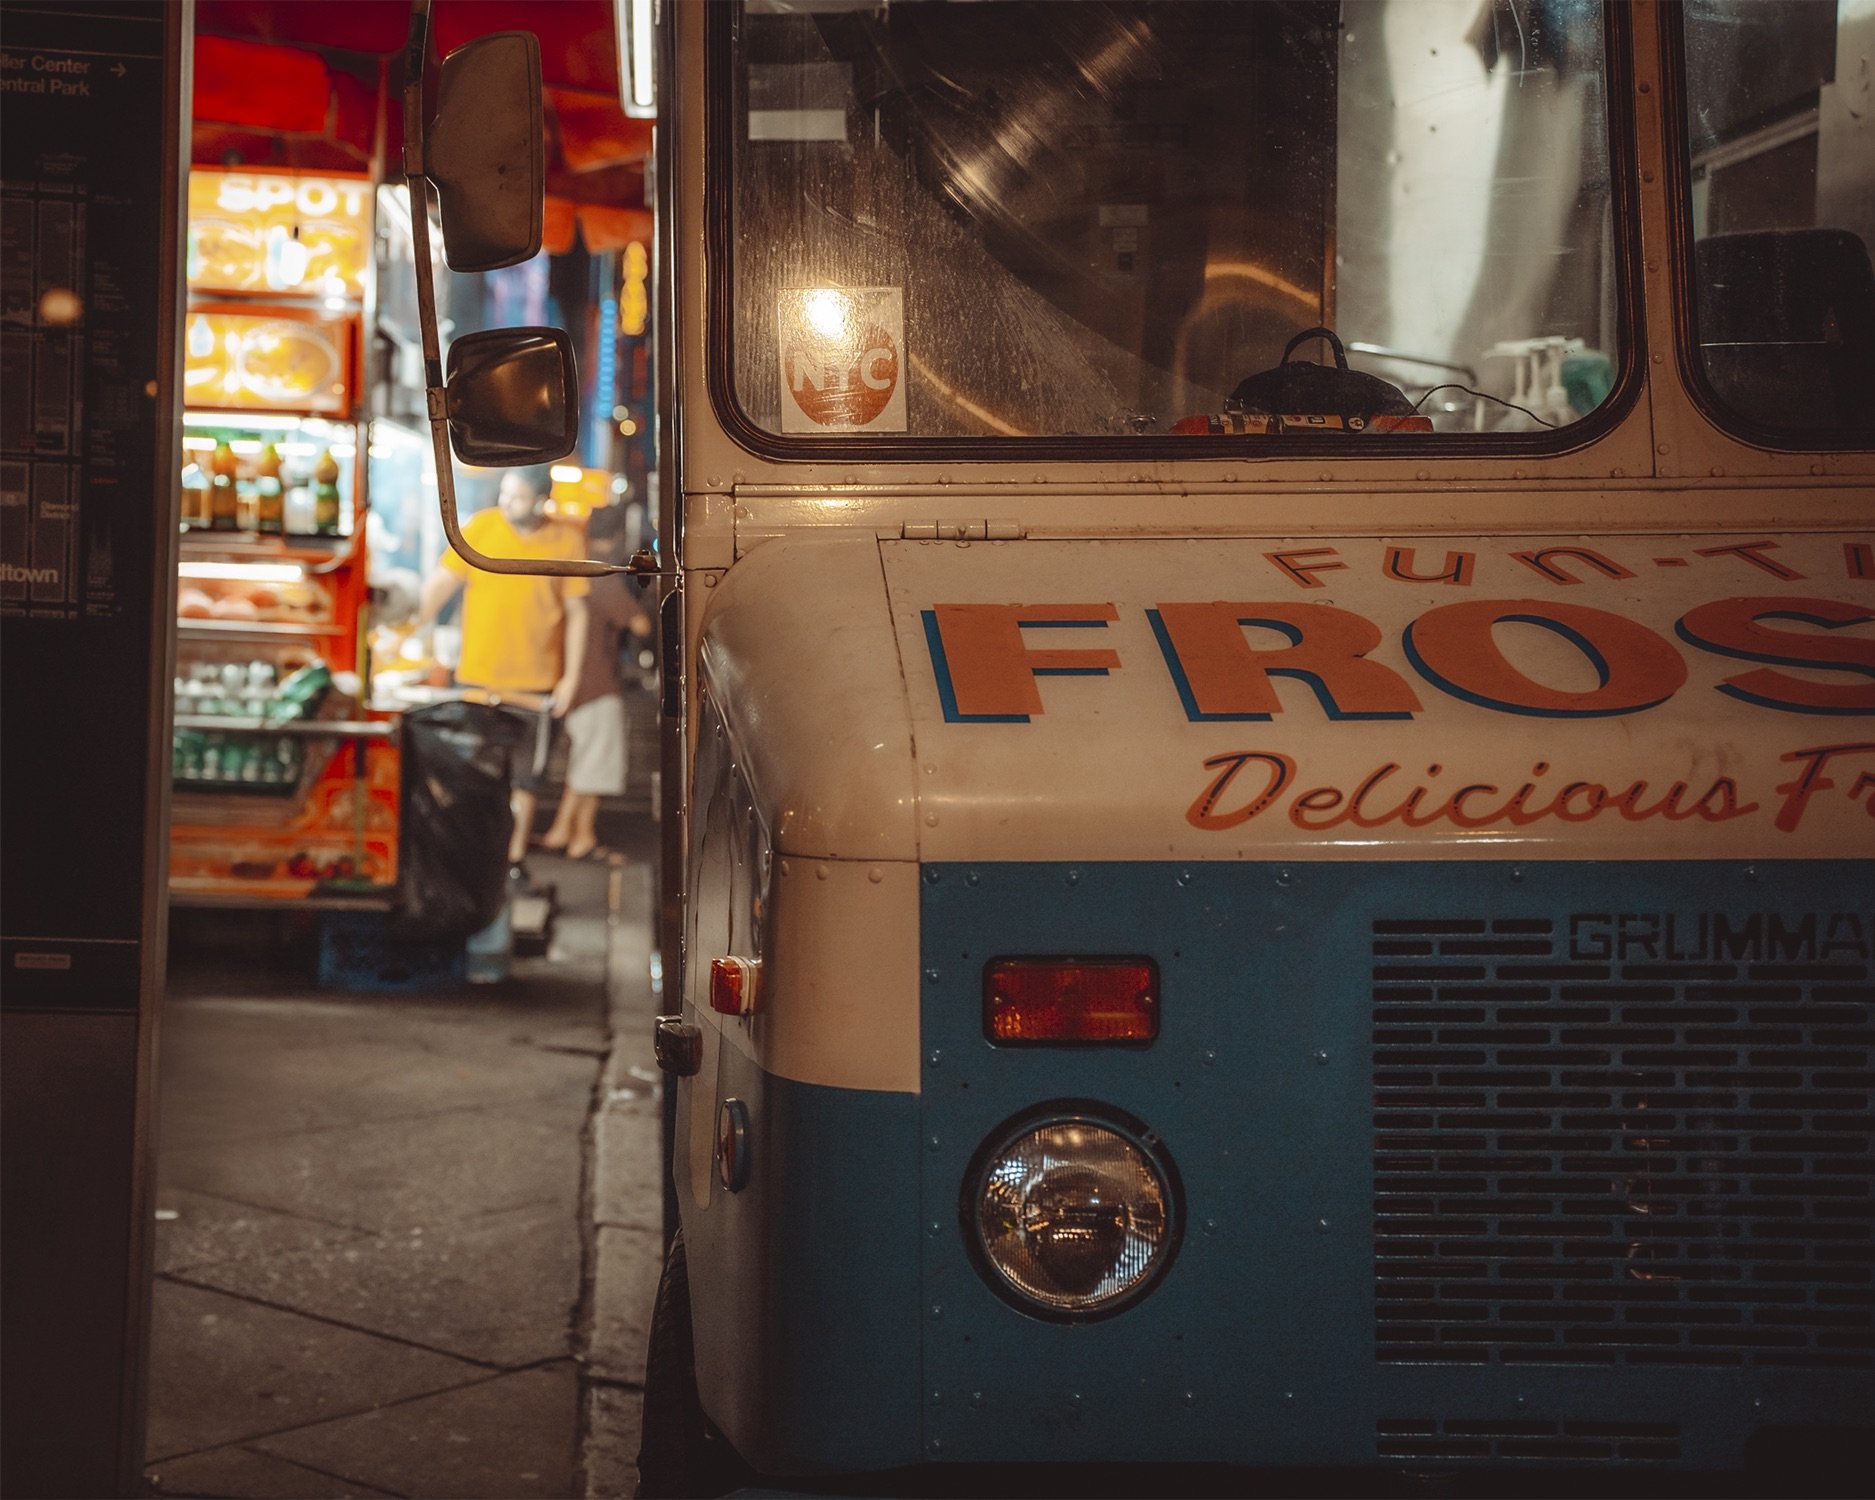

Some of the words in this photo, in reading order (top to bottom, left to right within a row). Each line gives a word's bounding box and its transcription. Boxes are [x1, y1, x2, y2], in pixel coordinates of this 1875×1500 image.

[0, 53, 28, 70] ller
[31, 55, 91, 75] Center
[50, 79, 90, 97] Park
[217, 177, 371, 216] SPOT
[793, 347, 893, 392] NYC
[921, 598, 1875, 723] FROS
[1186, 749, 1759, 832] Delicious
[1569, 912, 1875, 962] GRUMMA
